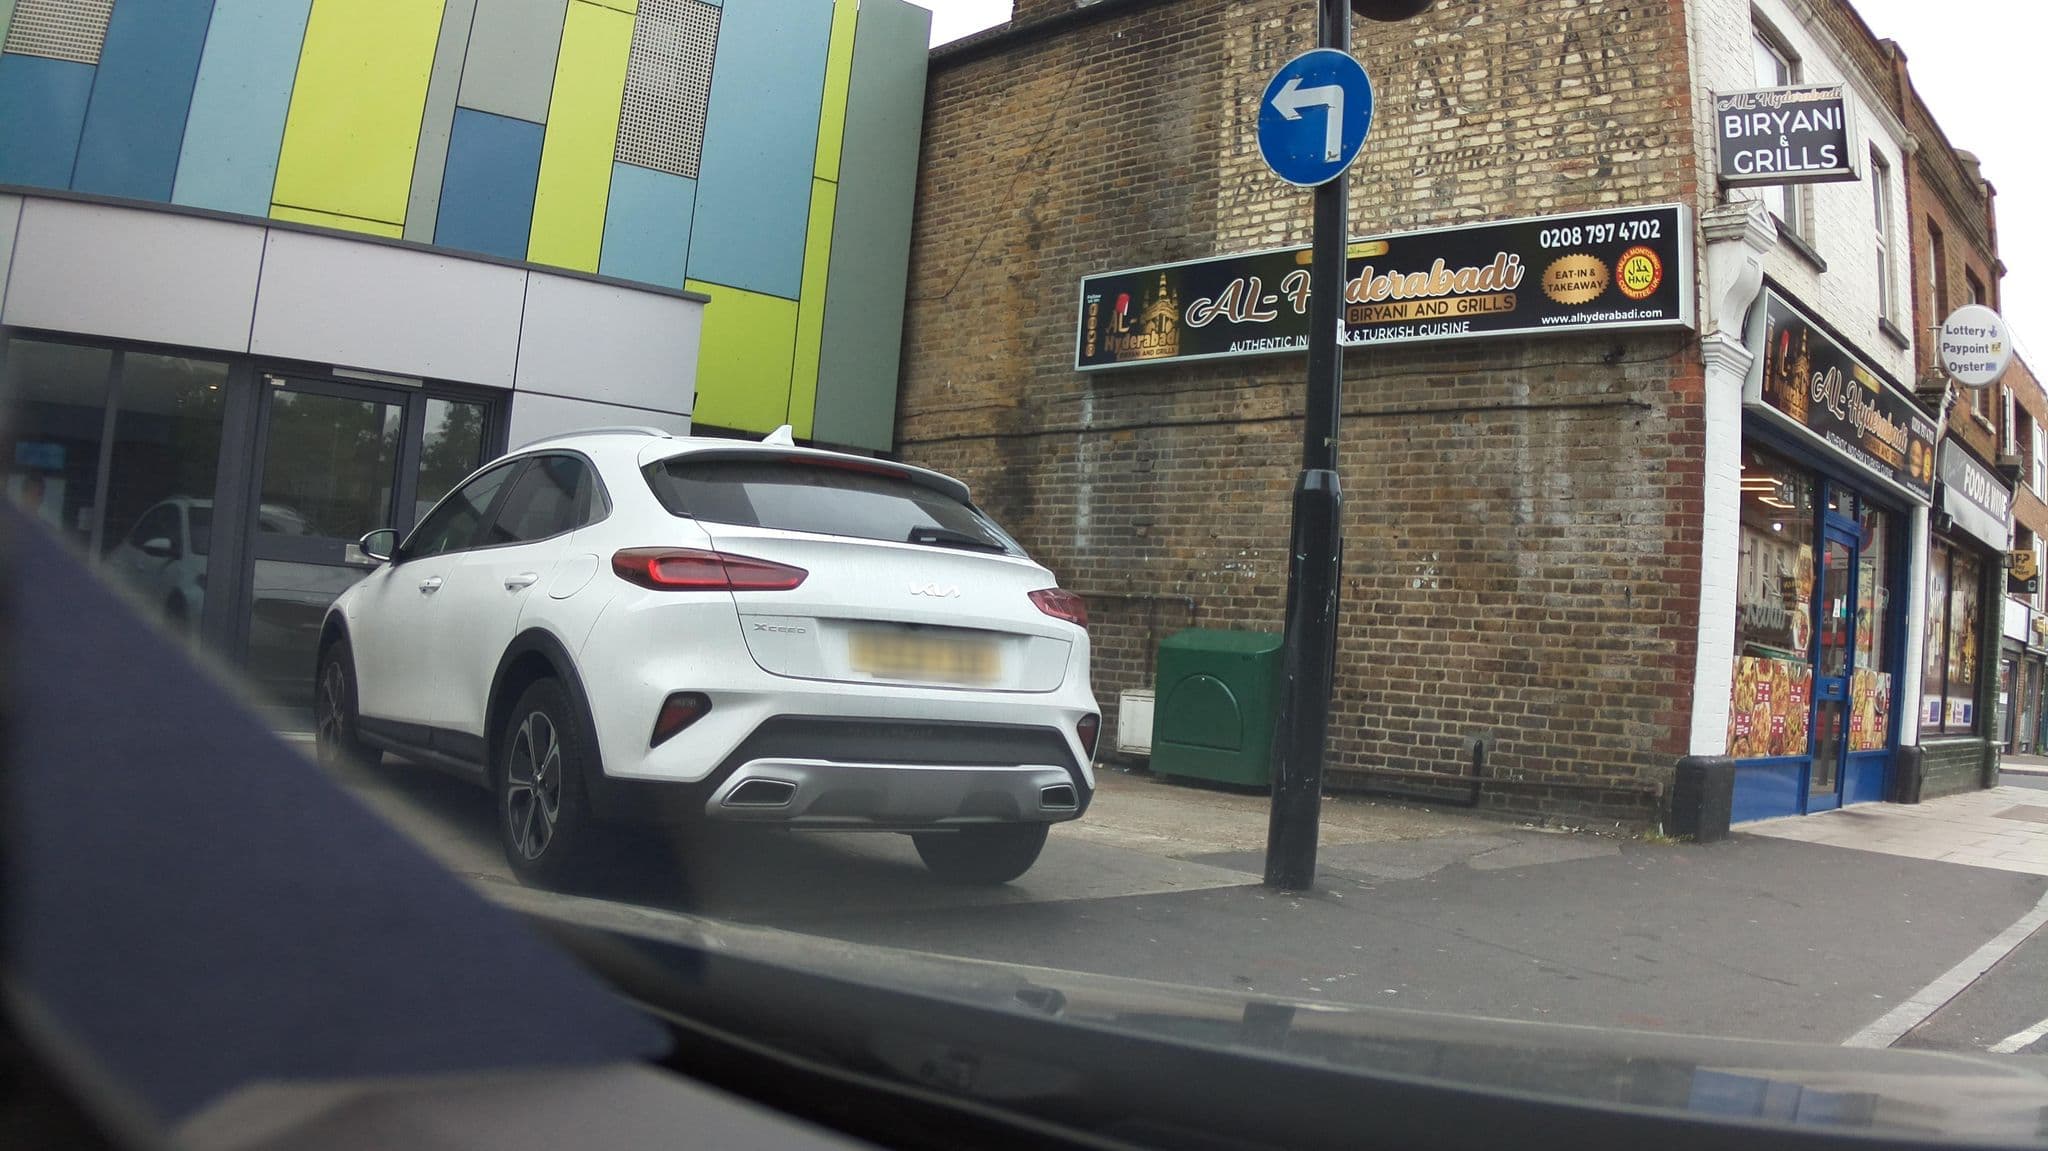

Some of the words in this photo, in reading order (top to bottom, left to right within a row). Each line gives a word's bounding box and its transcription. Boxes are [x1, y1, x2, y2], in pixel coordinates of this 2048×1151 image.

[1718, 89, 1842, 112] AL-Hyderabadi
[1725, 107, 1842, 138] BIRYANI
[1779, 135, 1790, 147] &
[1733, 144, 1838, 174] GRILLS
[1540, 226, 1582, 248] 0208
[1585, 223, 1615, 244] 797
[1618, 219, 1661, 241] 4702
[1555, 269, 1587, 280] EAT-IN
[1589, 268, 1596, 277] &
[1548, 280, 1604, 293] TAKEAWAY
[1350, 305, 1408, 322] BIRYANI
[1414, 301, 1449, 317] AND
[1456, 296, 1514, 313] GRILLS
[1541, 309, 1663, 324] www.alhyderabadi.com
[1229, 336, 1292, 352] AUTHENTIC
[1362, 326, 1415, 341] TURKISH
[1418, 322, 1470, 337] CUISINE
[1946, 325, 1986, 337] Lottery
[1942, 343, 1989, 356] Paypoint
[1949, 362, 1984, 373] Oyster
[1964, 463, 1985, 504] FOOD
[1984, 480, 1990, 509] &
[1990, 484, 2008, 522] WINE
